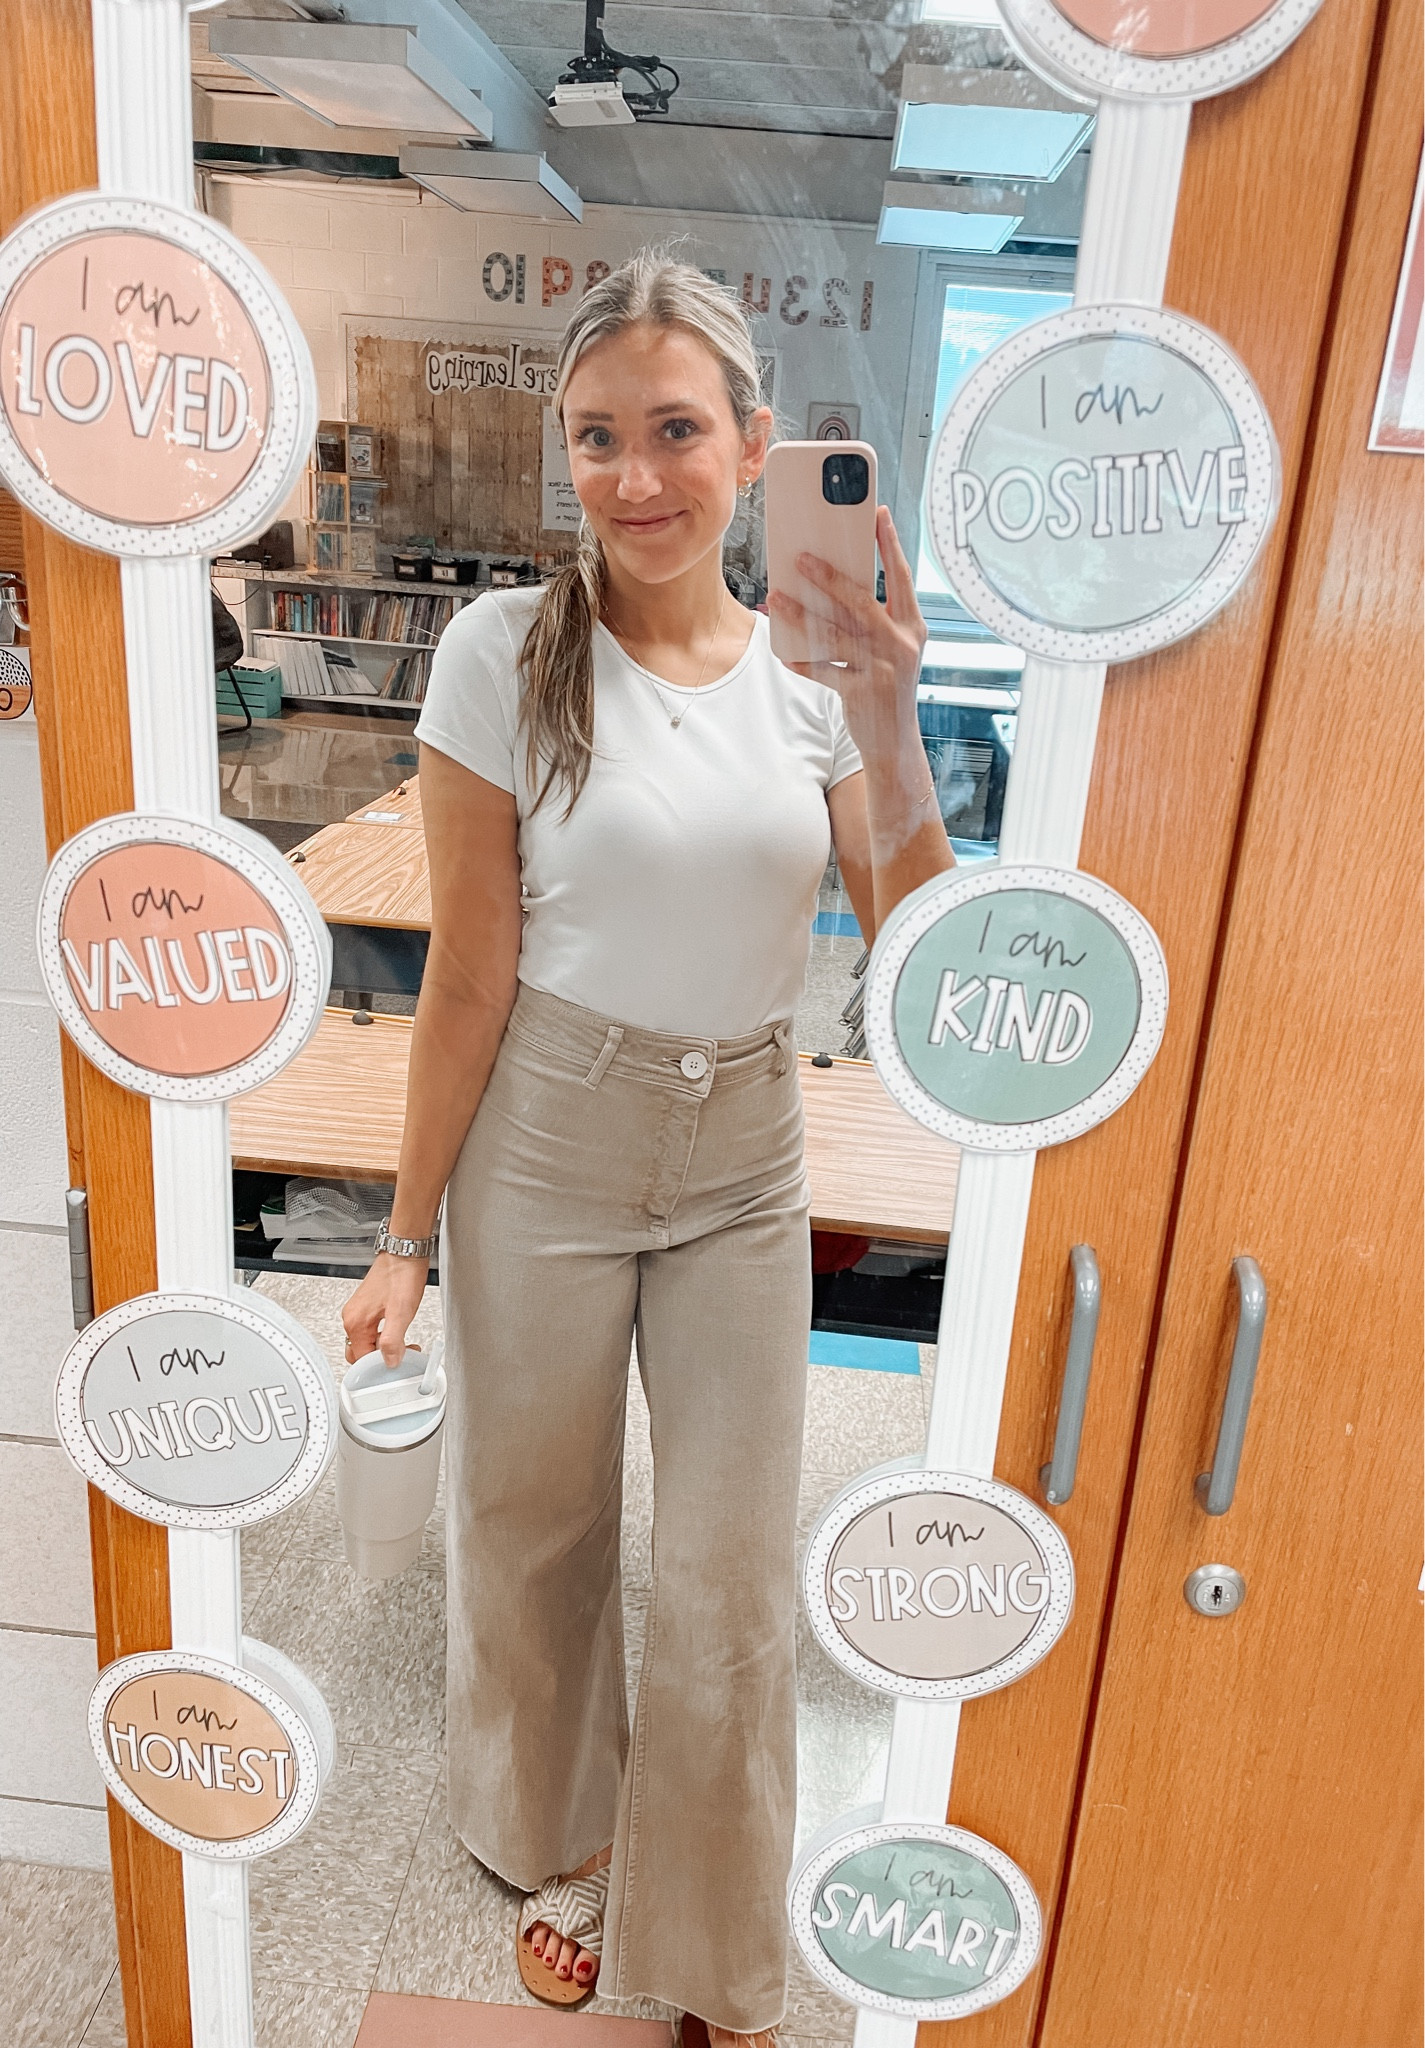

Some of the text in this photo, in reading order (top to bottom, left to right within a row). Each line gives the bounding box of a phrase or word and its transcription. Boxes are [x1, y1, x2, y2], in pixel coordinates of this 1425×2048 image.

[81, 256, 200, 327] I am
[16, 323, 250, 452] LOVED
[1075, 383, 1164, 425] am
[951, 445, 1248, 549] POSITIVE
[99, 878, 203, 922] I am
[60, 926, 292, 1012] VALUED
[978, 910, 1087, 968] I am
[928, 968, 1093, 1066] KIND
[127, 1345, 225, 1382] I am
[82, 1385, 302, 1467] UNIQUE
[916, 1520, 985, 1547] am
[830, 1560, 1051, 1622] STRONG
[177, 1704, 237, 1731] am
[107, 1721, 290, 1799] HONEST
[884, 1852, 973, 1899] I am
[811, 1882, 1018, 1978] SMART
